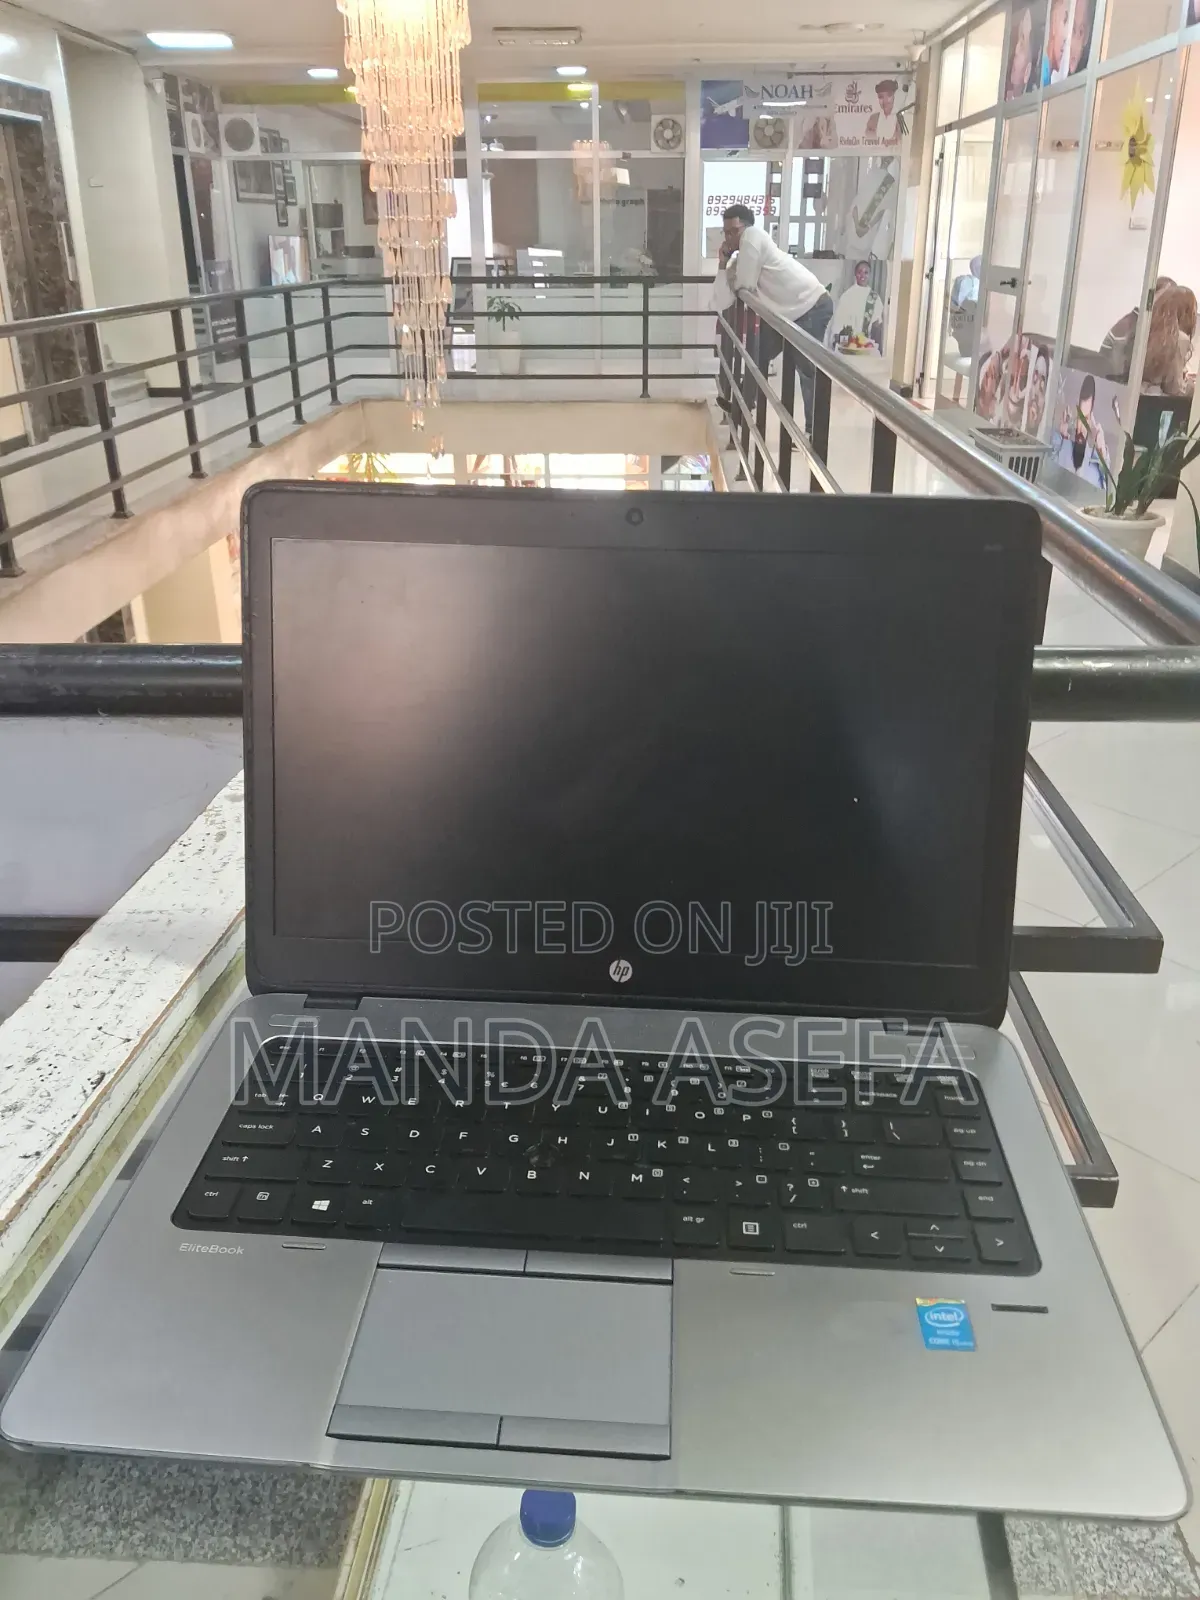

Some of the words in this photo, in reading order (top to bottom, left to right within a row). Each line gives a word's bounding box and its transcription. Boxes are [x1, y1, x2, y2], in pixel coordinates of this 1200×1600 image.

[761, 83, 814, 99] NOAH
[861, 136, 880, 146] Travel
[609, 959, 633, 983] hp
[313, 1093, 324, 1101] Q
[361, 1095, 376, 1104] W
[407, 1097, 417, 1106] E
[454, 1099, 465, 1107] R
[502, 1101, 512, 1110] T
[551, 1103, 561, 1112] Y
[598, 1105, 608, 1114] U
[645, 1108, 650, 1116] I
[694, 1111, 706, 1119] O
[742, 1113, 752, 1122] P
[311, 1125, 322, 1134] A
[360, 1127, 370, 1136] S
[409, 1129, 420, 1138] D
[458, 1131, 469, 1140] F
[508, 1134, 519, 1143] G
[557, 1136, 568, 1145] H
[606, 1138, 615, 1147] J
[657, 1140, 667, 1149] K
[707, 1143, 716, 1152] L
[322, 1159, 334, 1169] Z
[373, 1162, 385, 1171] X
[425, 1164, 436, 1174] C
[476, 1166, 487, 1176] V
[526, 1170, 537, 1180] B
[578, 1171, 590, 1181] N
[631, 1173, 643, 1183] M
[179, 1242, 245, 1256] EliteBook
